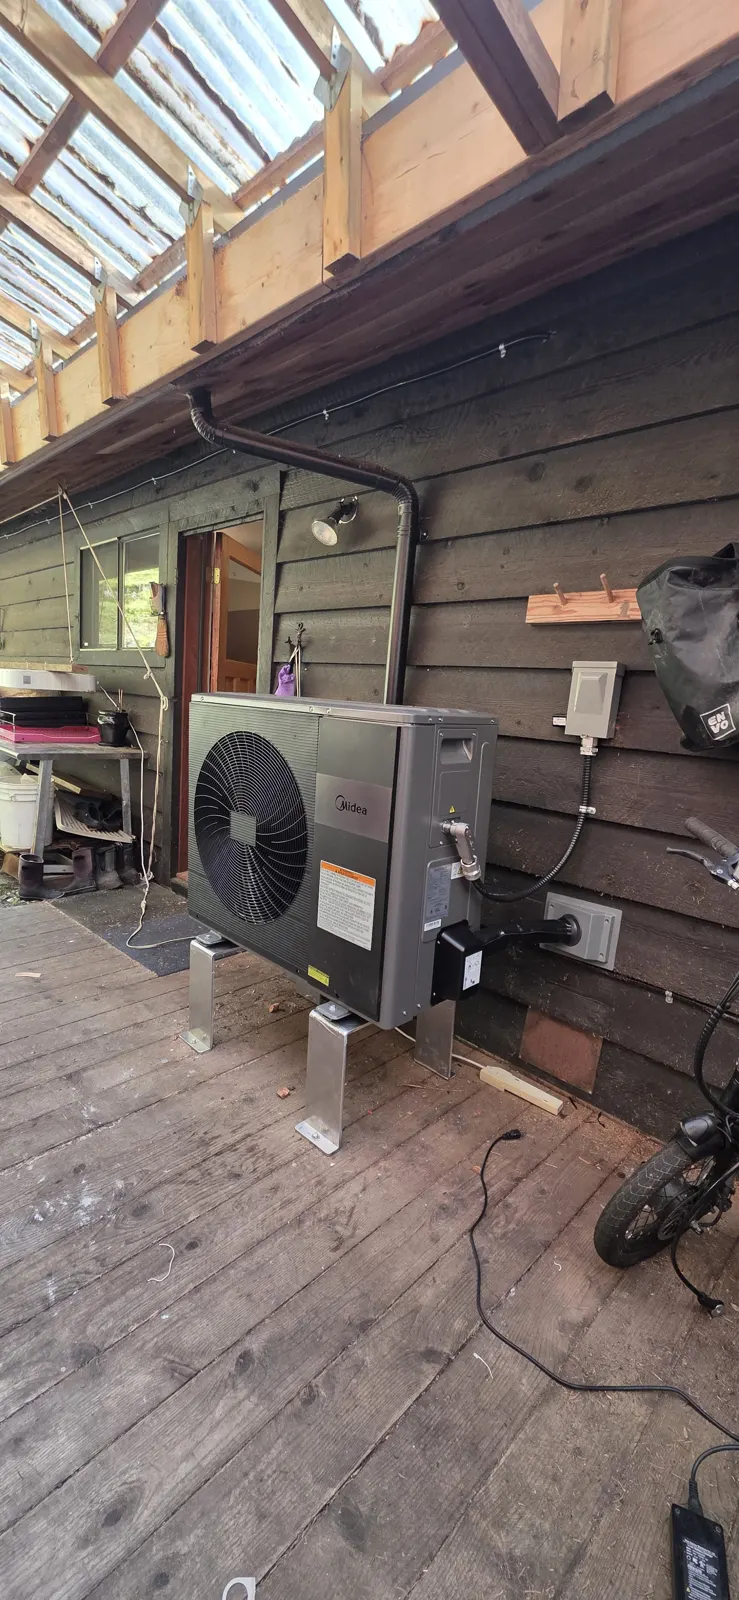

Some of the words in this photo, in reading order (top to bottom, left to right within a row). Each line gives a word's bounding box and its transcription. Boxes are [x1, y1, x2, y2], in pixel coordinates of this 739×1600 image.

[708, 711, 726, 726] EN
[710, 720, 729, 734] VO
[335, 794, 368, 816] Midea
